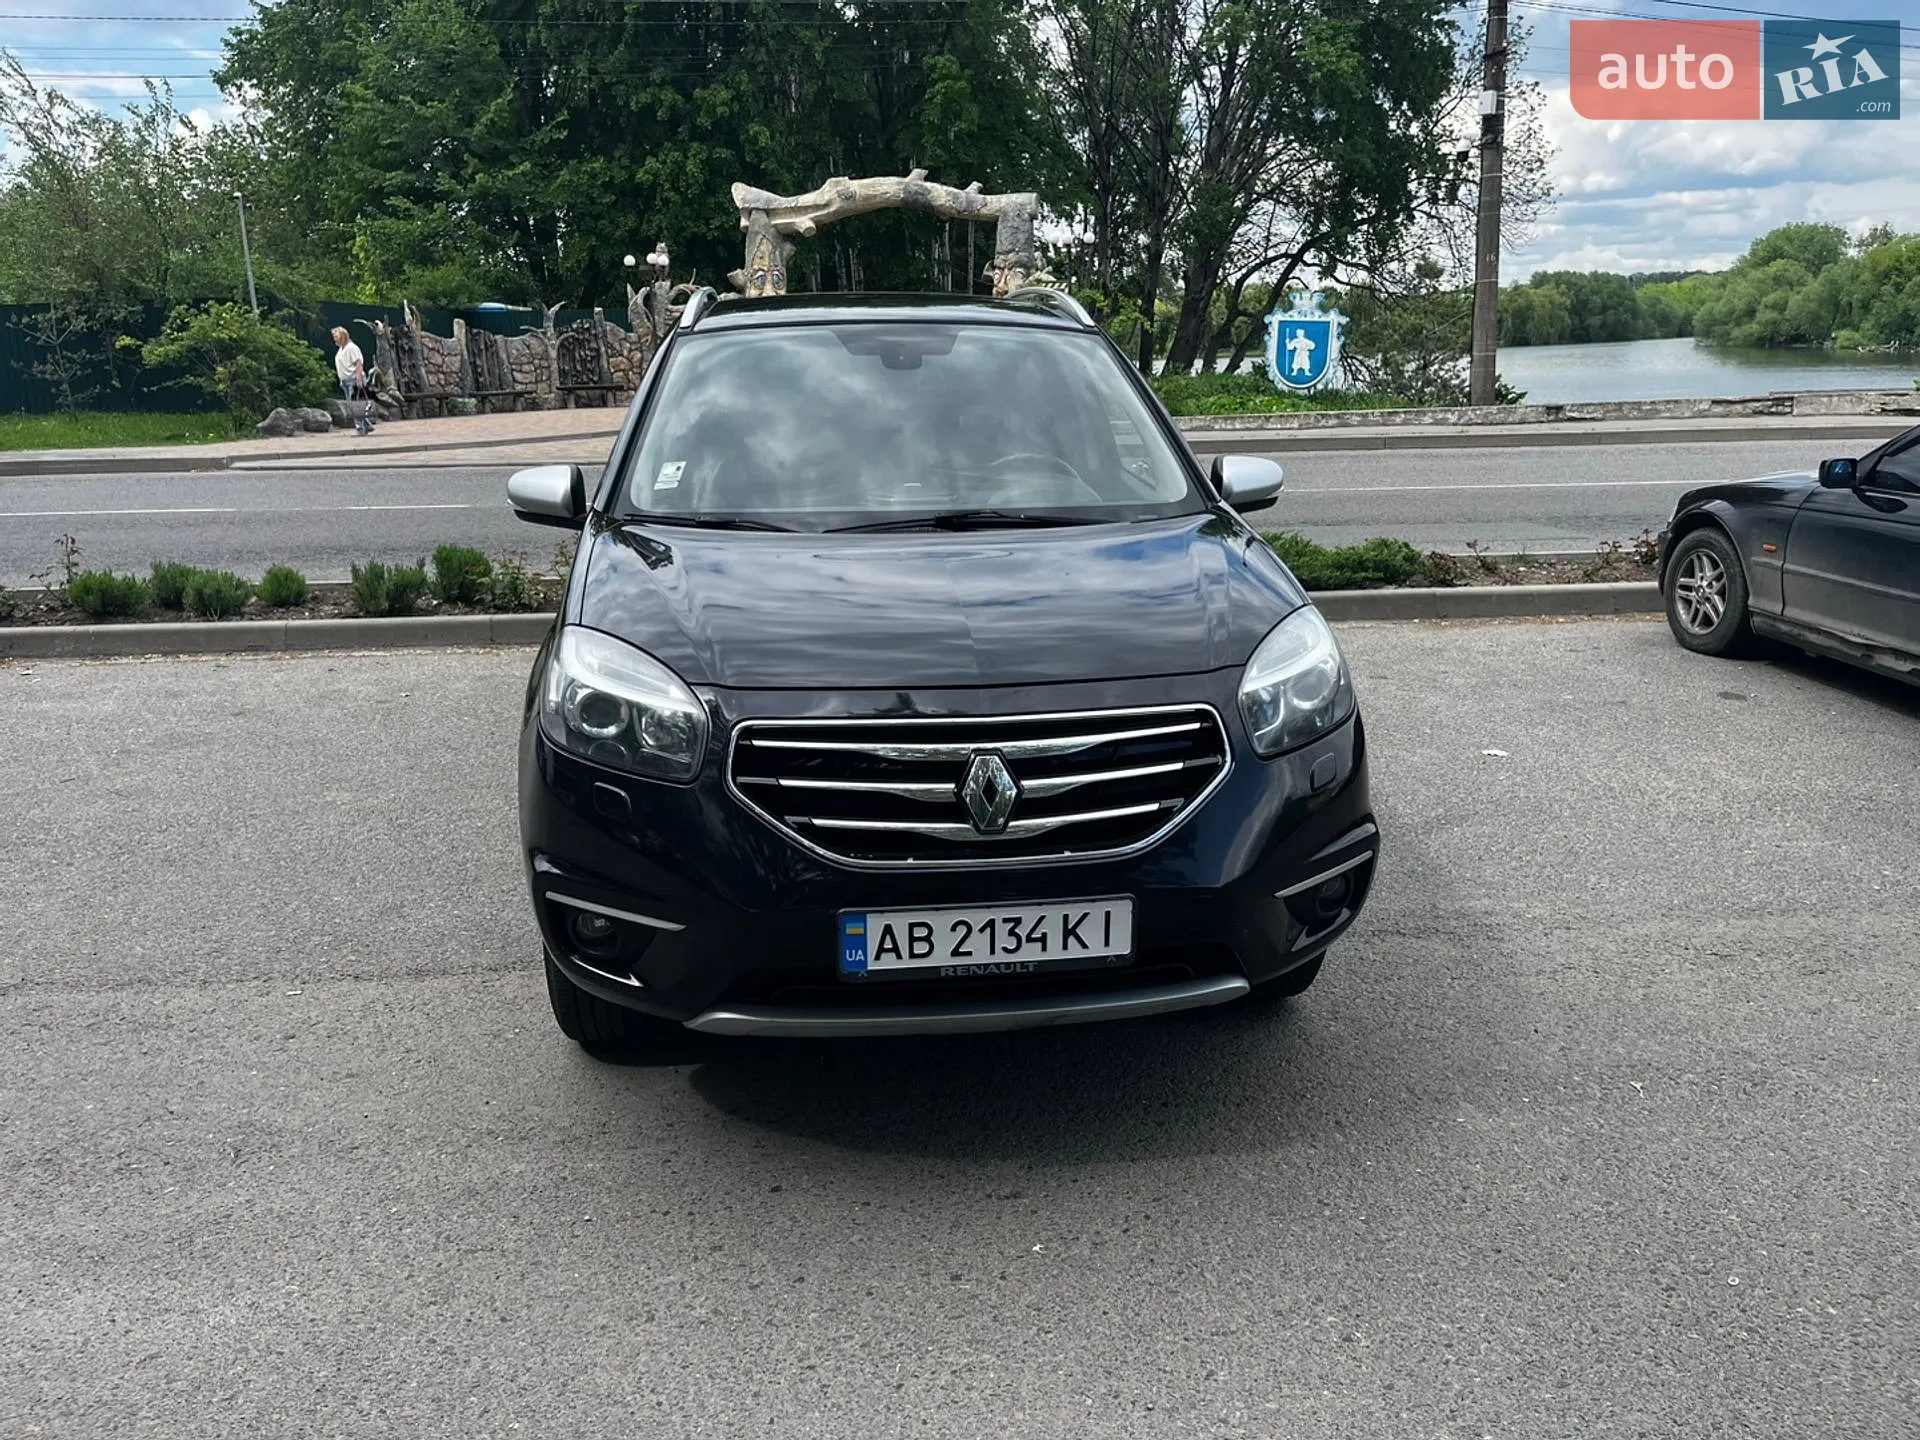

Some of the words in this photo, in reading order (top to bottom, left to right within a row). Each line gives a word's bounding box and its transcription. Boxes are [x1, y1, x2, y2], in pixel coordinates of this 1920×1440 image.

[873, 921, 935, 961] AB
[950, 914, 1048, 957] 2134
[1062, 911, 1111, 951] KI
[846, 949, 865, 962] UA
[940, 962, 1039, 977] RENAULT
